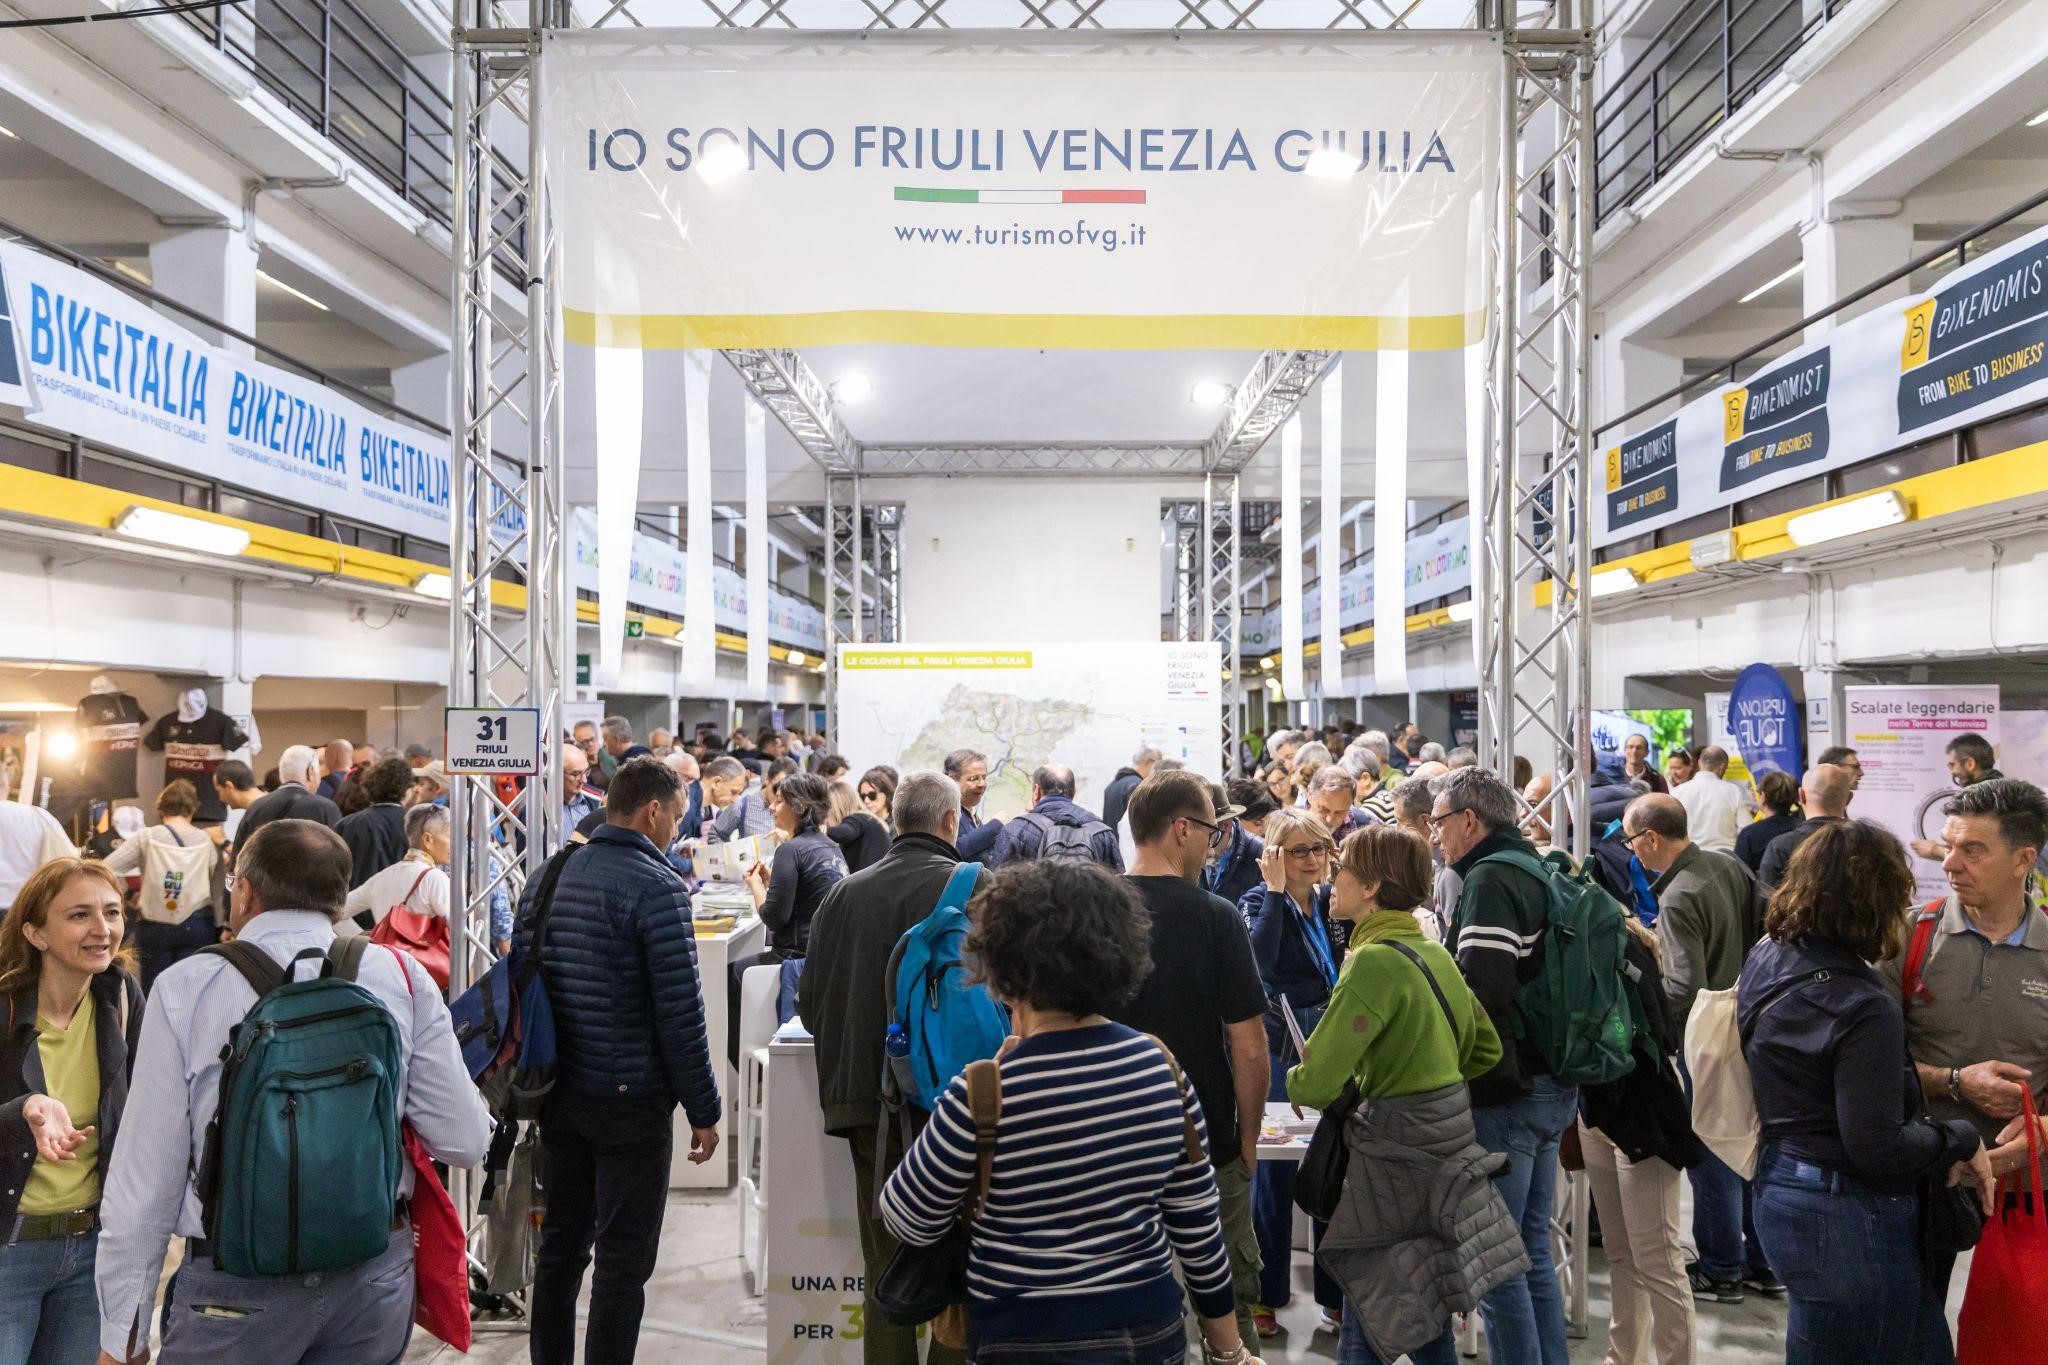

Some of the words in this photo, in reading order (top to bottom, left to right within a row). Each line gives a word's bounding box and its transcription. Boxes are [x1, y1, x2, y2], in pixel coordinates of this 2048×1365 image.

[588, 128, 647, 172] IO
[854, 125, 1004, 171] FRIULI
[1023, 127, 1258, 173] VENEZIA
[894, 219, 1147, 252] www.turismofvg.it
[1937, 256, 2048, 338] BIKENOMIS
[31, 282, 208, 425] BIKEITALIA
[1749, 364, 1823, 420] BIKENOMIST
[1918, 380, 1947, 406] FROM
[1947, 369, 1973, 396] BIKE
[1973, 363, 1989, 387] TO
[1991, 341, 2045, 380] BUSINESS
[228, 370, 346, 474] BIKEITALIA
[361, 427, 449, 509] BIKEITALIA
[1623, 431, 1672, 474] BIKENOMIST
[476, 715, 507, 741] 31
[1851, 701, 1902, 714] Scalate
[1907, 701, 1995, 717] leggendarie
[1912, 719, 1933, 728] Terre
[1935, 719, 1948, 728] del
[1950, 719, 1986, 728] Monviso
[452, 758, 496, 768] VENEZIA
[497, 758, 531, 768] GIULIA
[476, 745, 508, 754] FRIULI
[791, 1276, 836, 1291] UNA
[793, 1324, 834, 1339] PER
